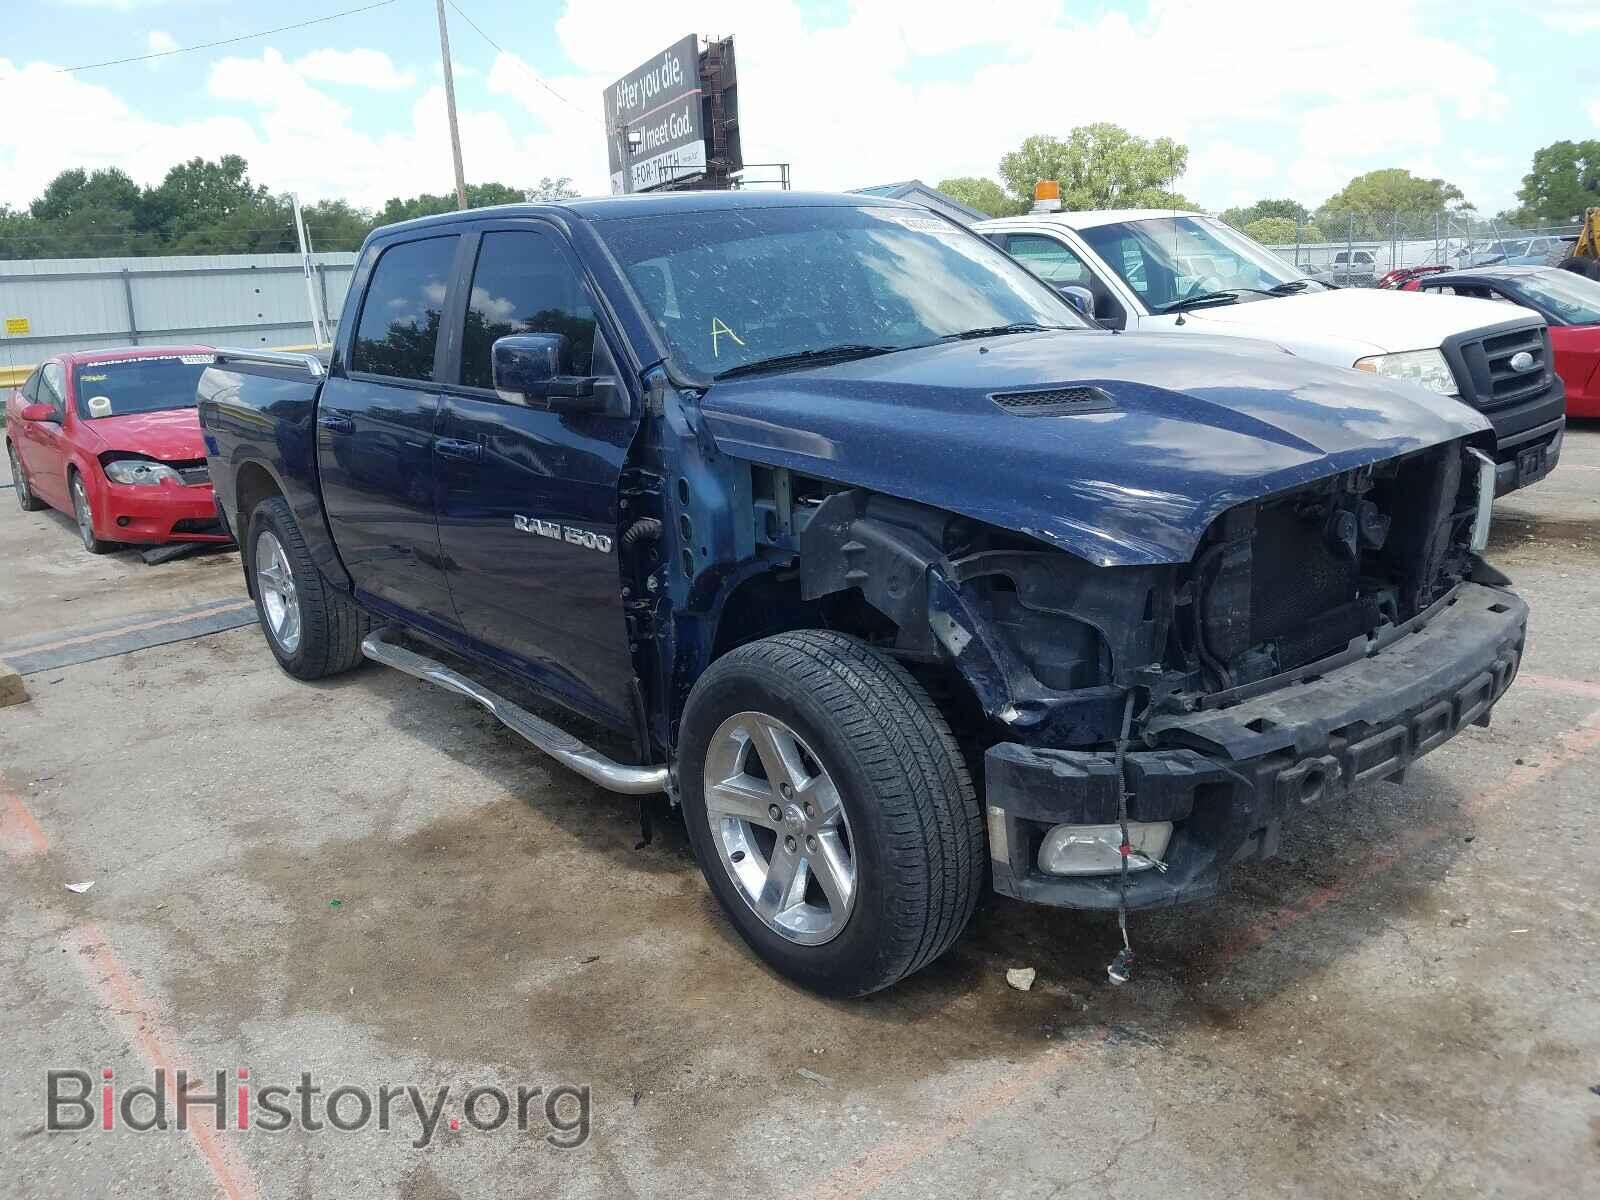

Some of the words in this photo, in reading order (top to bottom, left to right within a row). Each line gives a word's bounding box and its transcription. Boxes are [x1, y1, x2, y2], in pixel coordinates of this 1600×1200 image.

[616, 79, 639, 115] After
[639, 67, 660, 110] you
[662, 52, 683, 89] die,
[647, 119, 669, 151] meet
[669, 105, 693, 140] God.
[710, 317, 745, 358] A
[513, 513, 562, 541] RAM
[563, 525, 612, 553] 1500
